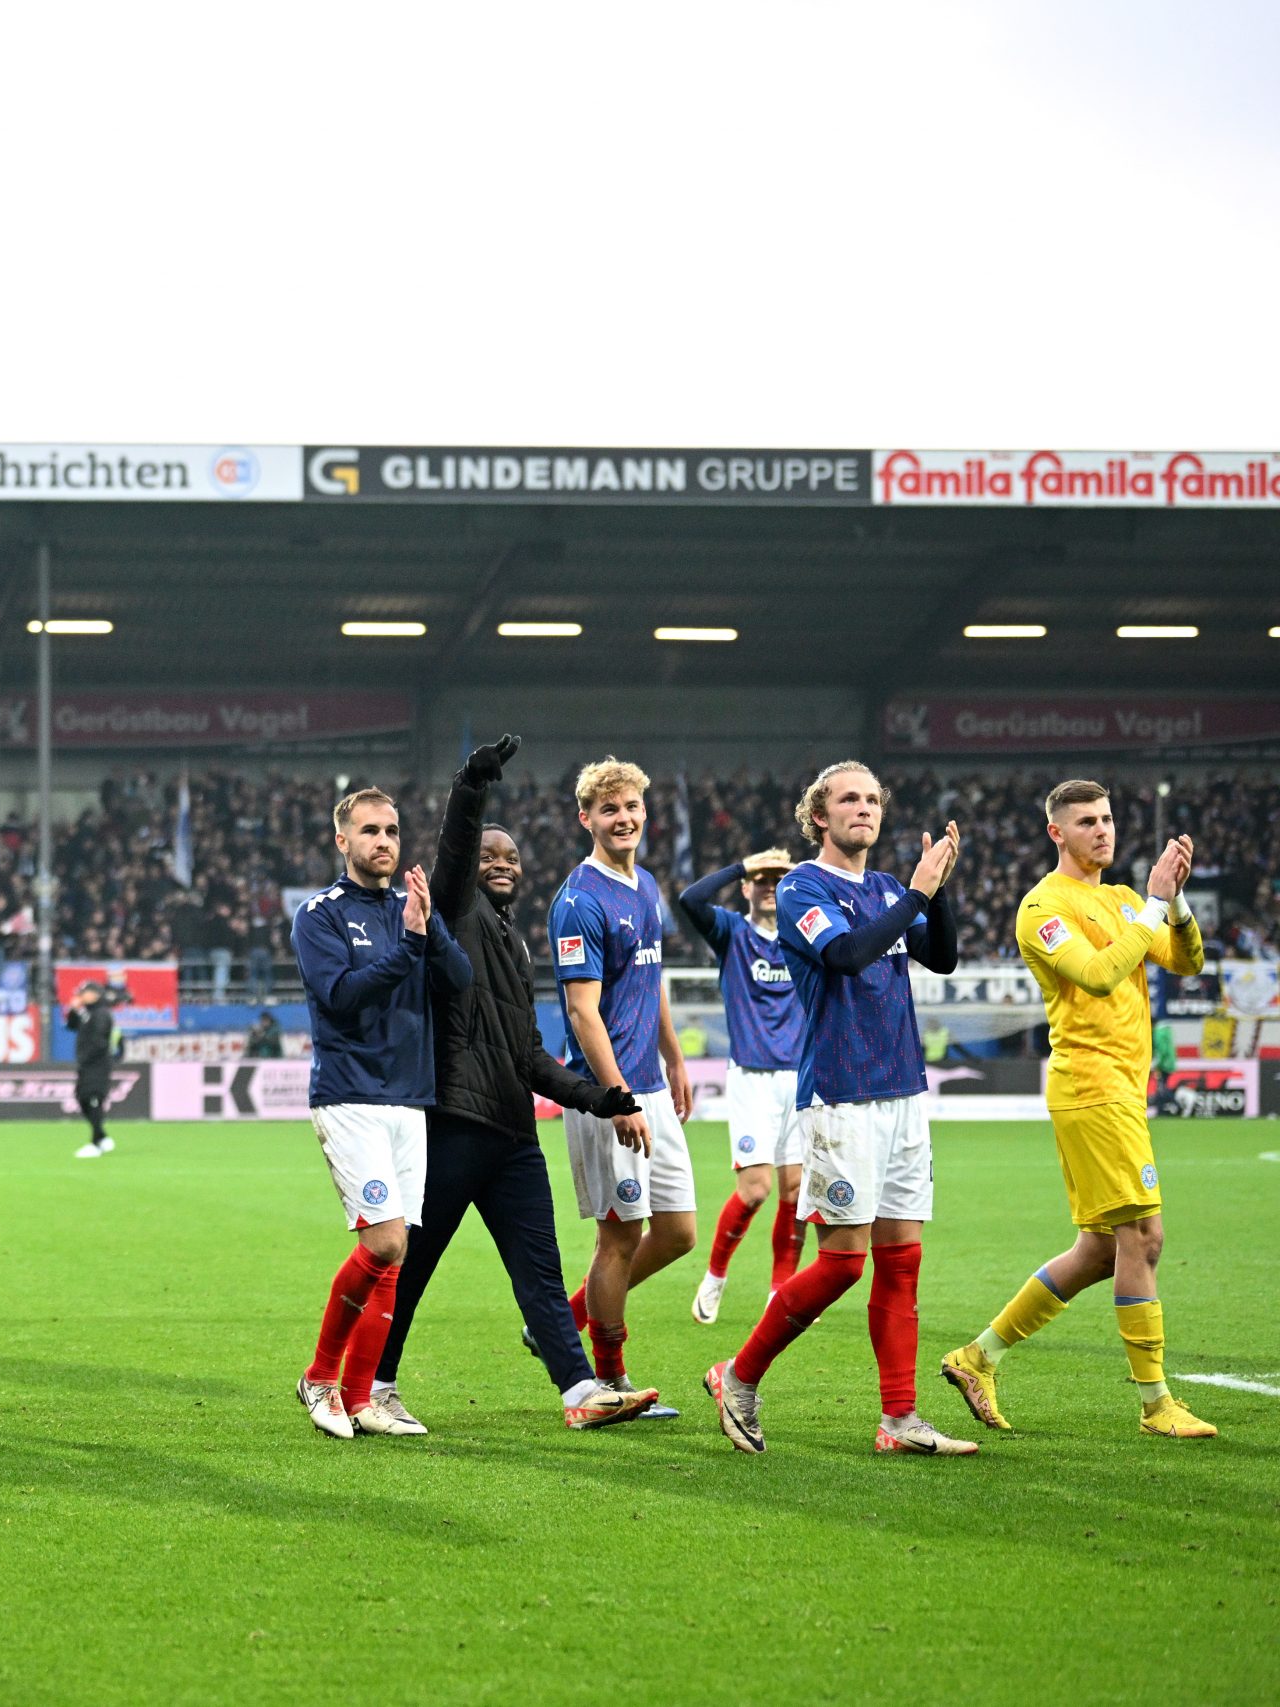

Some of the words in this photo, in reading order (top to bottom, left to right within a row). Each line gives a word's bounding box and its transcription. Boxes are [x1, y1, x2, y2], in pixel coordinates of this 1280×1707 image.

[380, 456, 687, 491] GLINDEMANN
[696, 458, 860, 491] GRUPPE
[878, 450, 1012, 504] famila
[1020, 451, 1154, 506] famila
